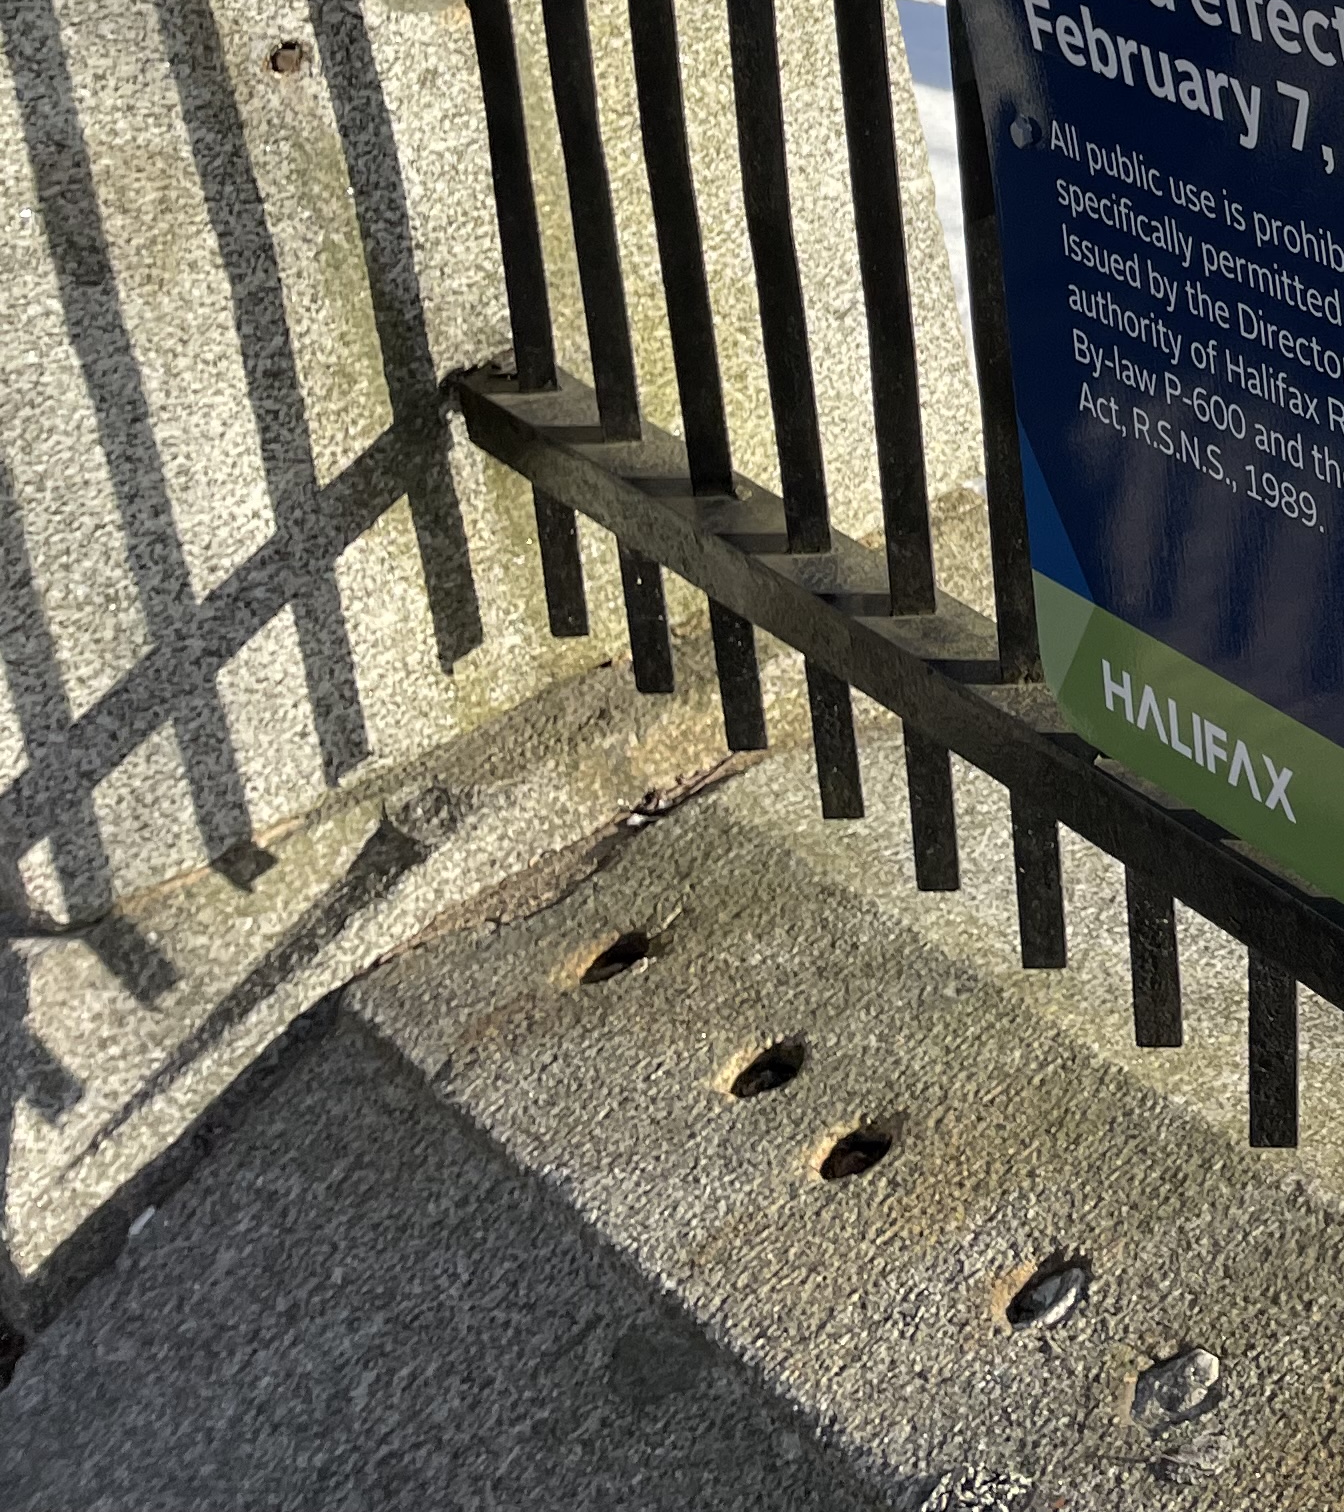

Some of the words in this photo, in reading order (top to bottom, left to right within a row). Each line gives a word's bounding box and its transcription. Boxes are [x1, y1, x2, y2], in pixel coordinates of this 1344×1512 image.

[1051, 120, 1080, 161] All
[1086, 142, 1163, 196] public
[1169, 177, 1216, 218] use
[1224, 189, 1246, 231] is
[1276, 80, 1334, 174] 7,
[1056, 179, 1192, 267] specifically
[1201, 242, 1342, 326] permitted
[1062, 223, 1141, 289] Issued
[1147, 259, 1177, 312] by
[1185, 280, 1230, 329] the
[1068, 284, 1182, 365] authority
[1191, 340, 1217, 374] of
[1225, 349, 1320, 424] Halifax
[1073, 328, 1156, 396] By-law
[1164, 371, 1246, 439] P-600
[1254, 423, 1304, 469] and
[1079, 382, 1126, 437] Act,
[1133, 407, 1237, 493] R.S.N.S.,
[1245, 465, 1326, 534] 1989.
[1102, 659, 1296, 823] HALIFAX
